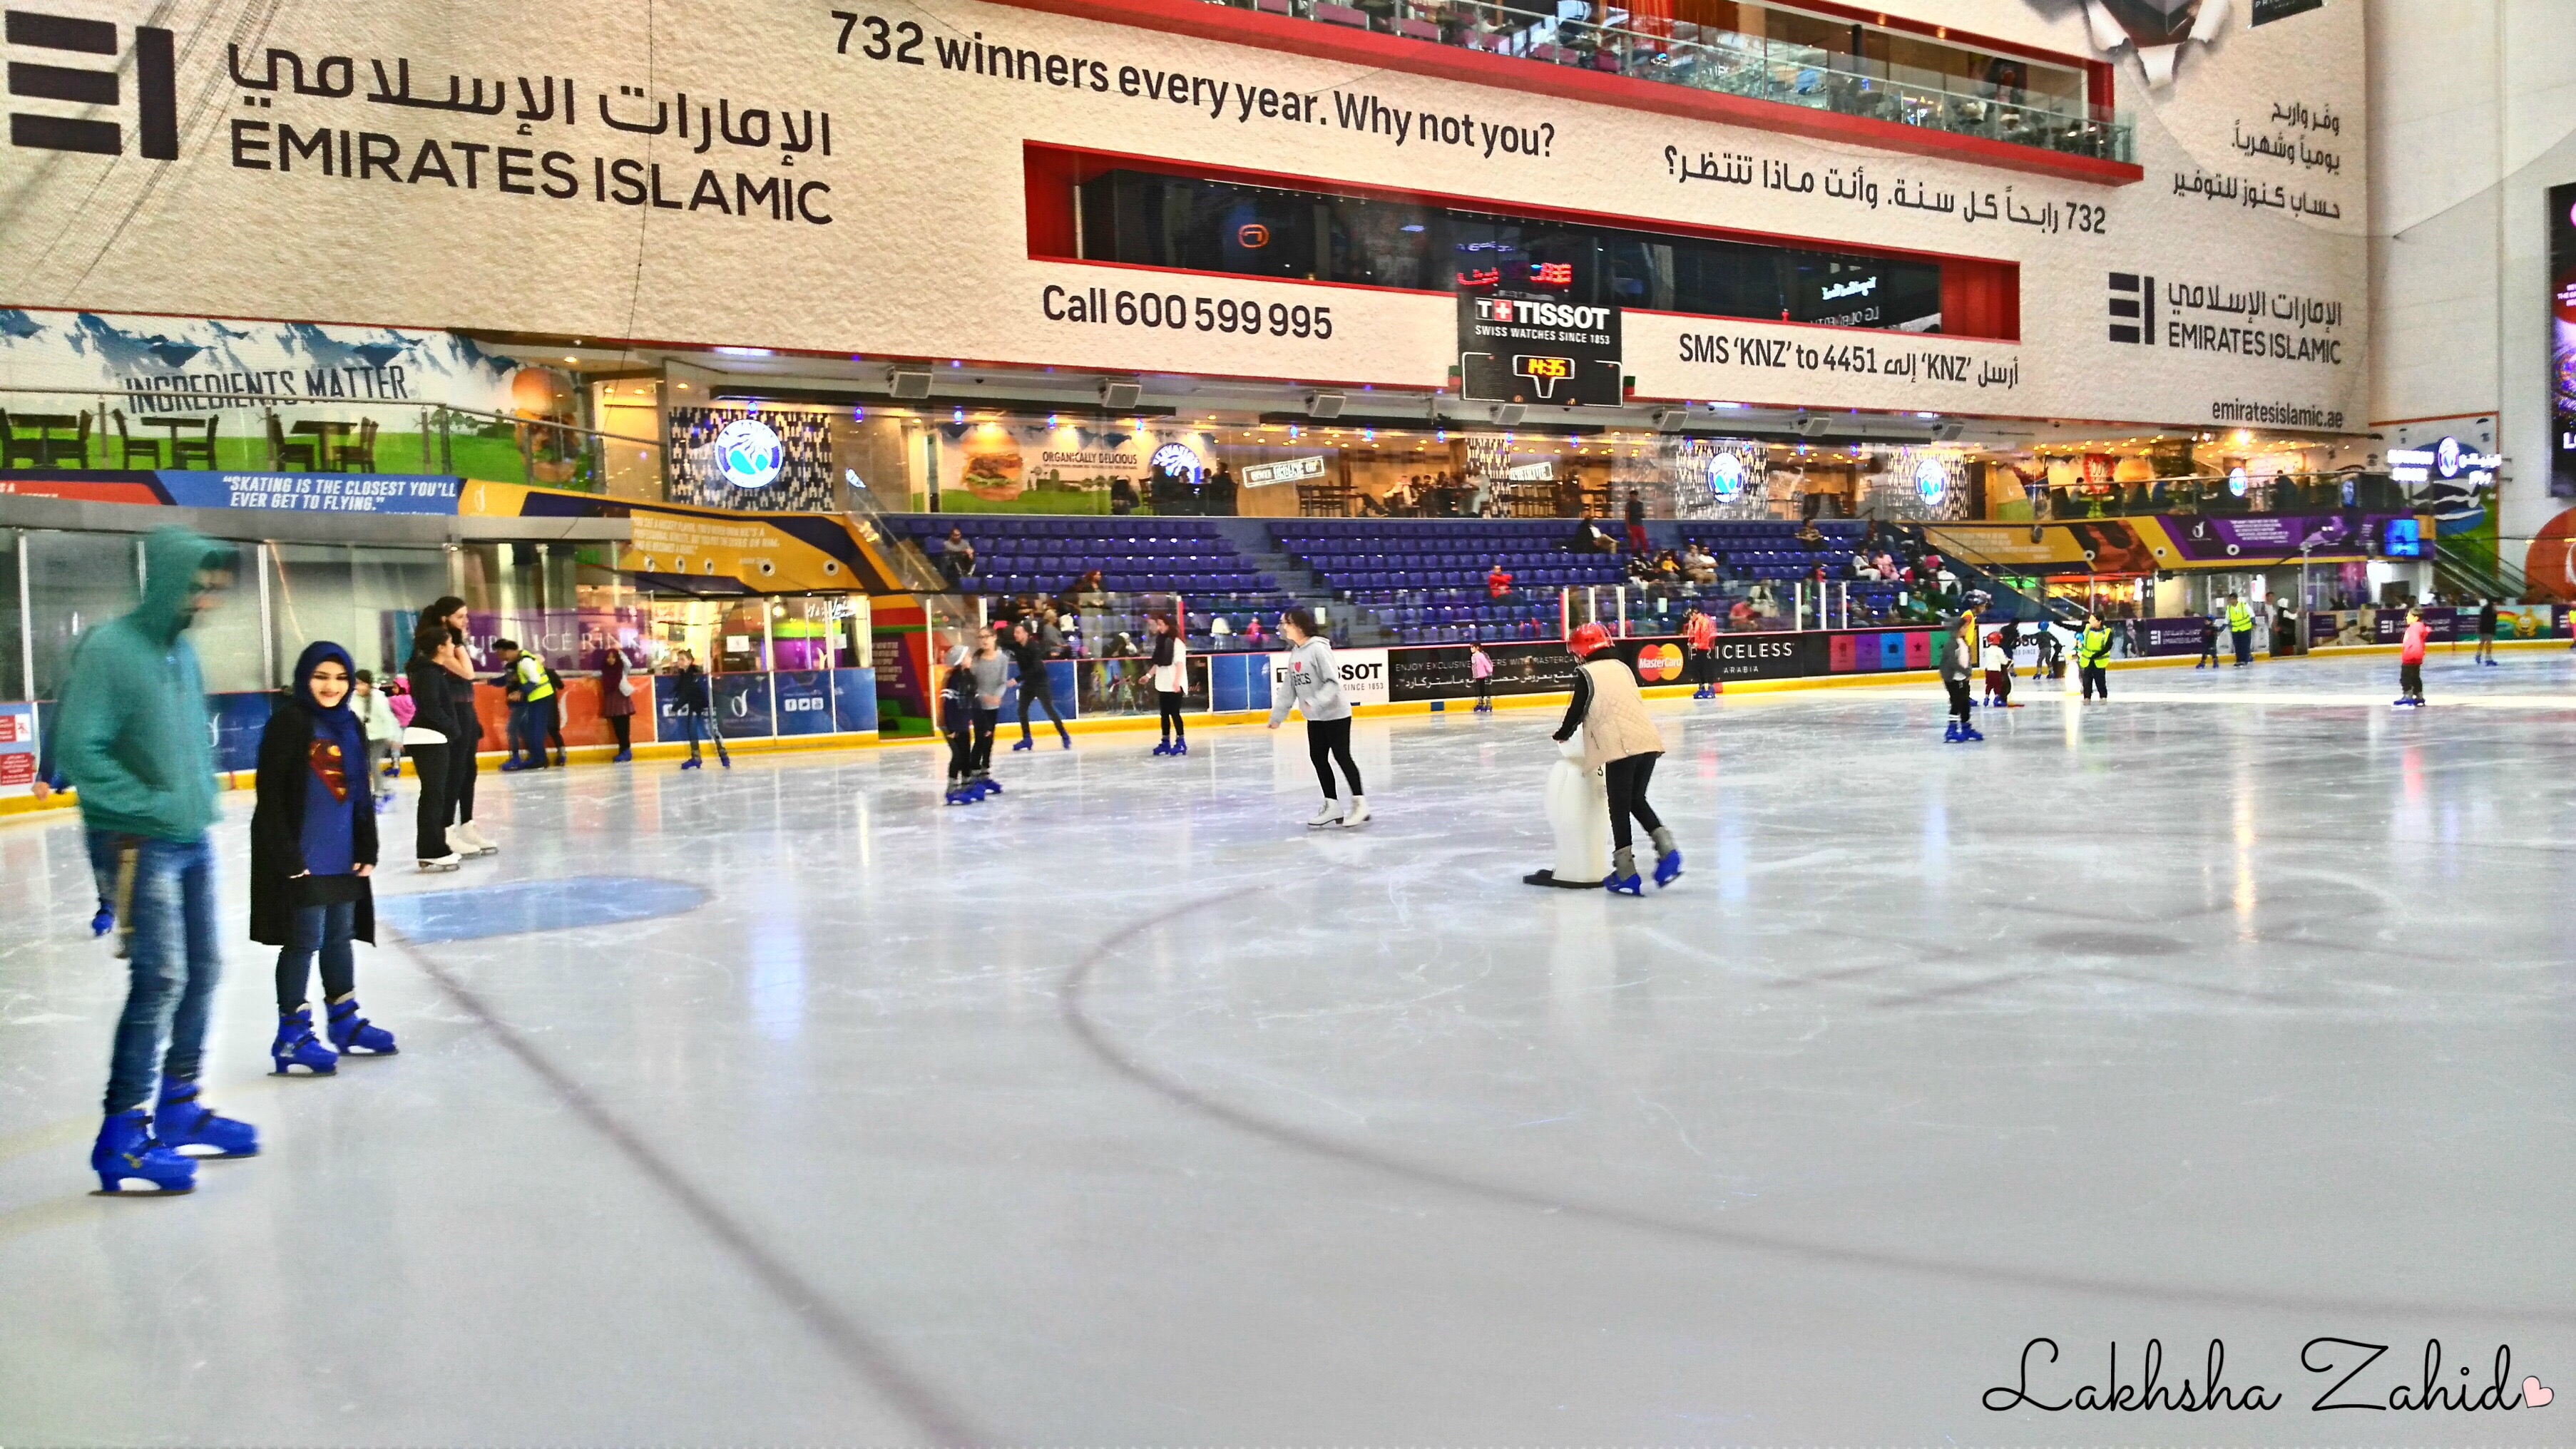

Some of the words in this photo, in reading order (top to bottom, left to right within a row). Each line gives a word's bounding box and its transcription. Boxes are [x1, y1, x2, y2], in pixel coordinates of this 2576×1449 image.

[228, 43, 575, 137] الإسلامي
[832, 10, 925, 65] 732
[934, 31, 1109, 93] winners
[1118, 65, 1227, 119] every
[1235, 82, 1327, 126] year.
[1334, 91, 1412, 145] Why
[1419, 111, 1475, 147] not
[1481, 123, 1555, 158] you?
[598, 85, 832, 167] الإمارات
[230, 118, 579, 200] EMIRATES
[594, 156, 832, 225] ISLAMIC
[1664, 145, 1752, 185] تنتظر؟
[1764, 158, 1815, 193] ماذا
[1824, 165, 1879, 209] وأنت
[1886, 177, 1955, 213] سنة.
[2172, 170, 2238, 200] للتوفير
[2242, 178, 2285, 209] كنوز
[1963, 190, 1998, 223] كل
[2065, 201, 2106, 235] 732
[2291, 192, 2341, 219] حساب
[1043, 285, 1106, 324] Call
[1115, 290, 1186, 329] 600
[1195, 297, 1261, 334] 599
[1268, 303, 1333, 339] 995
[1513, 299, 1610, 330] TISSOT
[2168, 282, 2266, 324] الإسلامي
[2271, 294, 2341, 334] الإمارات
[1475, 325, 1508, 337] SWISS
[1510, 327, 1556, 341] WATCHES
[1559, 331, 1588, 343] SINCE
[1590, 334, 1610, 345] 1853
[2168, 322, 2266, 357] EMIRATES
[2269, 333, 2341, 365] ISLAMIC
[1679, 332, 1729, 365] SMS
[1796, 347, 1819, 369] to
[1823, 345, 1878, 374] 4451
[1884, 354, 1917, 383] إلى
[126, 369, 298, 414] INGREDIENTS
[305, 365, 409, 404] MATTER
[1978, 357, 2019, 389] أرسل
[2212, 398, 2344, 429] emiratesislamic.ae
[1043, 451, 1097, 464] ORGANICALLY
[1098, 453, 1138, 464] DELICIOUS
[230, 491, 267, 508] EVER
[270, 493, 298, 508] GET
[302, 494, 321, 510] TO
[296, 478, 310, 493] IS
[316, 479, 343, 495] THE
[345, 481, 407, 496] CLOSEST
[534, 633, 573, 652] ICE
[1396, 663, 1424, 672] ENJOY
[1426, 660, 1472, 670] EXCLUSIVE
[1509, 657, 1532, 666] WITH
[1638, 657, 1682, 670] MasterCard
[1723, 665, 1759, 675] ARABIA
